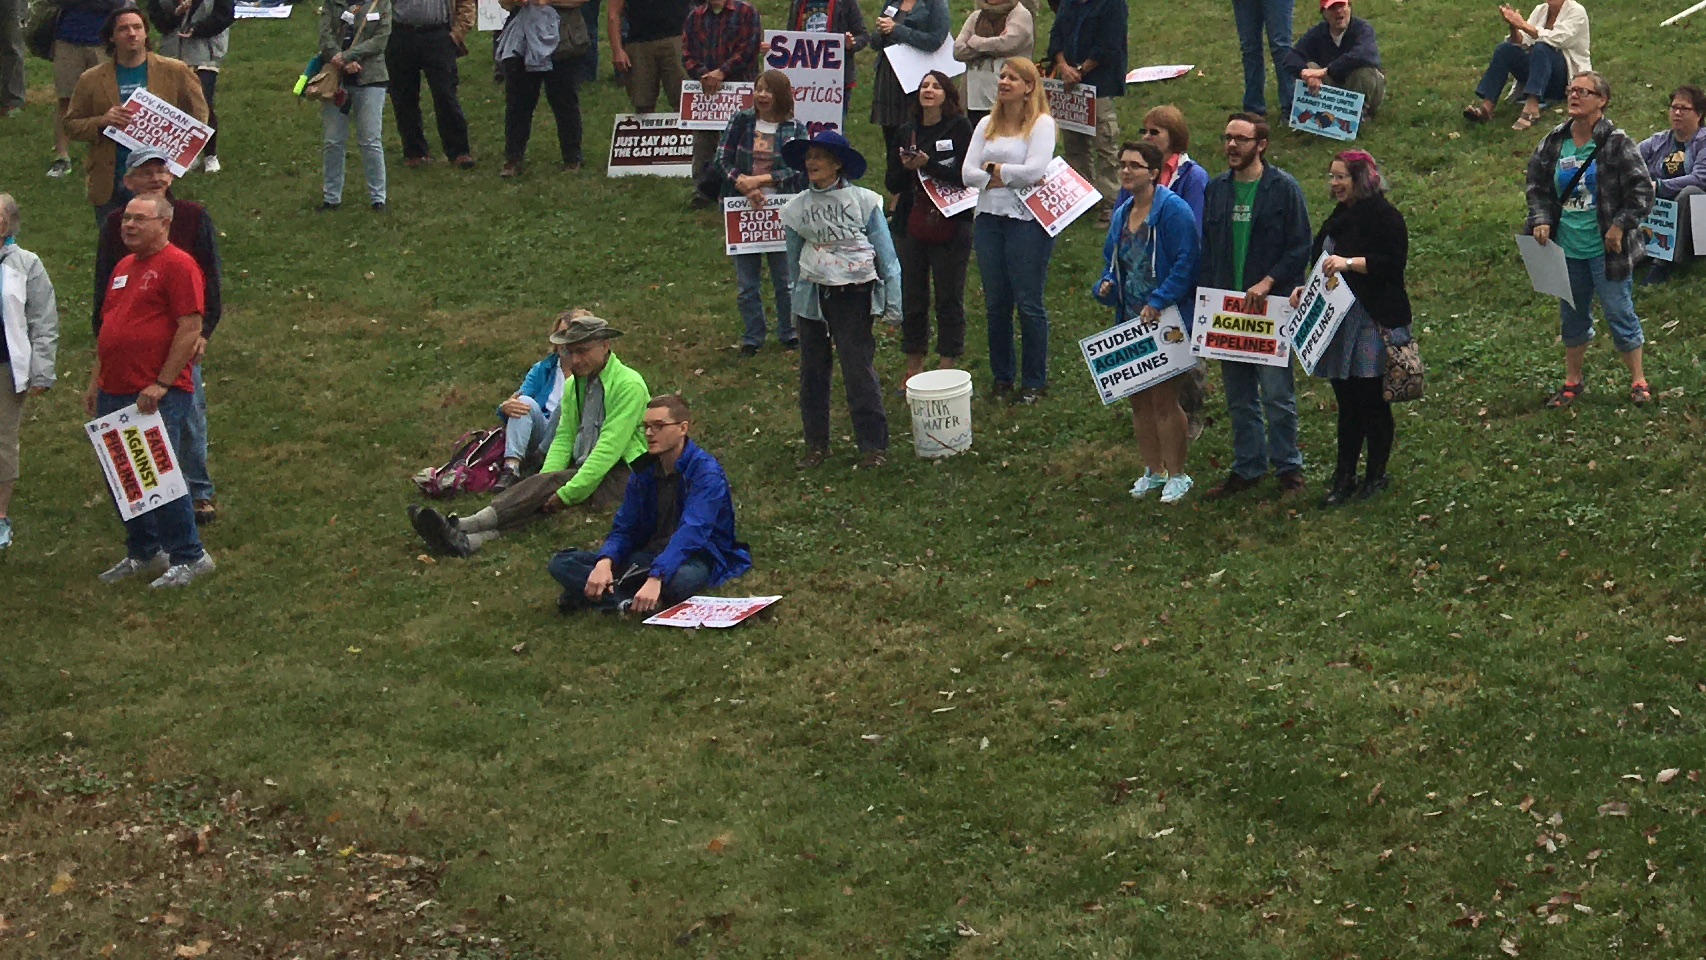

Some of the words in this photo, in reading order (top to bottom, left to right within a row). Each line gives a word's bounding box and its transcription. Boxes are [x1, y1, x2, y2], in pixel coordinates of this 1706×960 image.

[766, 35, 843, 70] SAVE
[684, 83, 702, 91] GOV.
[692, 93, 720, 103] STOP
[721, 93, 743, 103] THE
[793, 78, 843, 104] erica's
[1050, 91, 1072, 101] STOP
[1073, 94, 1088, 106] THE
[135, 92, 155, 108] GOV.
[155, 103, 191, 126] HOGAN:
[690, 102, 744, 112] POTOMAC
[1050, 100, 1089, 113] POTOMAC
[131, 113, 190, 153] POTOMAC
[136, 107, 170, 128] STOP
[168, 125, 194, 144] THE
[641, 118, 664, 127] YOU'RE
[613, 147, 631, 158] THE
[632, 146, 651, 157] GAS
[653, 145, 693, 157] PIPELINE
[615, 135, 640, 147] JUST
[640, 135, 660, 146] SAY
[661, 134, 678, 145] NO
[679, 133, 694, 145] TO
[1035, 176, 1062, 202] STOP
[740, 210, 774, 222] STOP
[800, 203, 855, 226] DRINK
[1288, 274, 1322, 336] STUDENTS
[1212, 315, 1275, 335] AGAINST
[1294, 293, 1327, 347] AGAINST
[1300, 303, 1335, 361] PIPELINES
[1087, 320, 1159, 357] STUDENTS
[1206, 333, 1275, 353] PIPELINES
[1095, 339, 1156, 373] AGAINST
[1100, 352, 1169, 390] PIPELINES
[921, 415, 960, 430] WATER
[106, 430, 142, 501] PIPELINES
[123, 428, 159, 488] AGAINST
